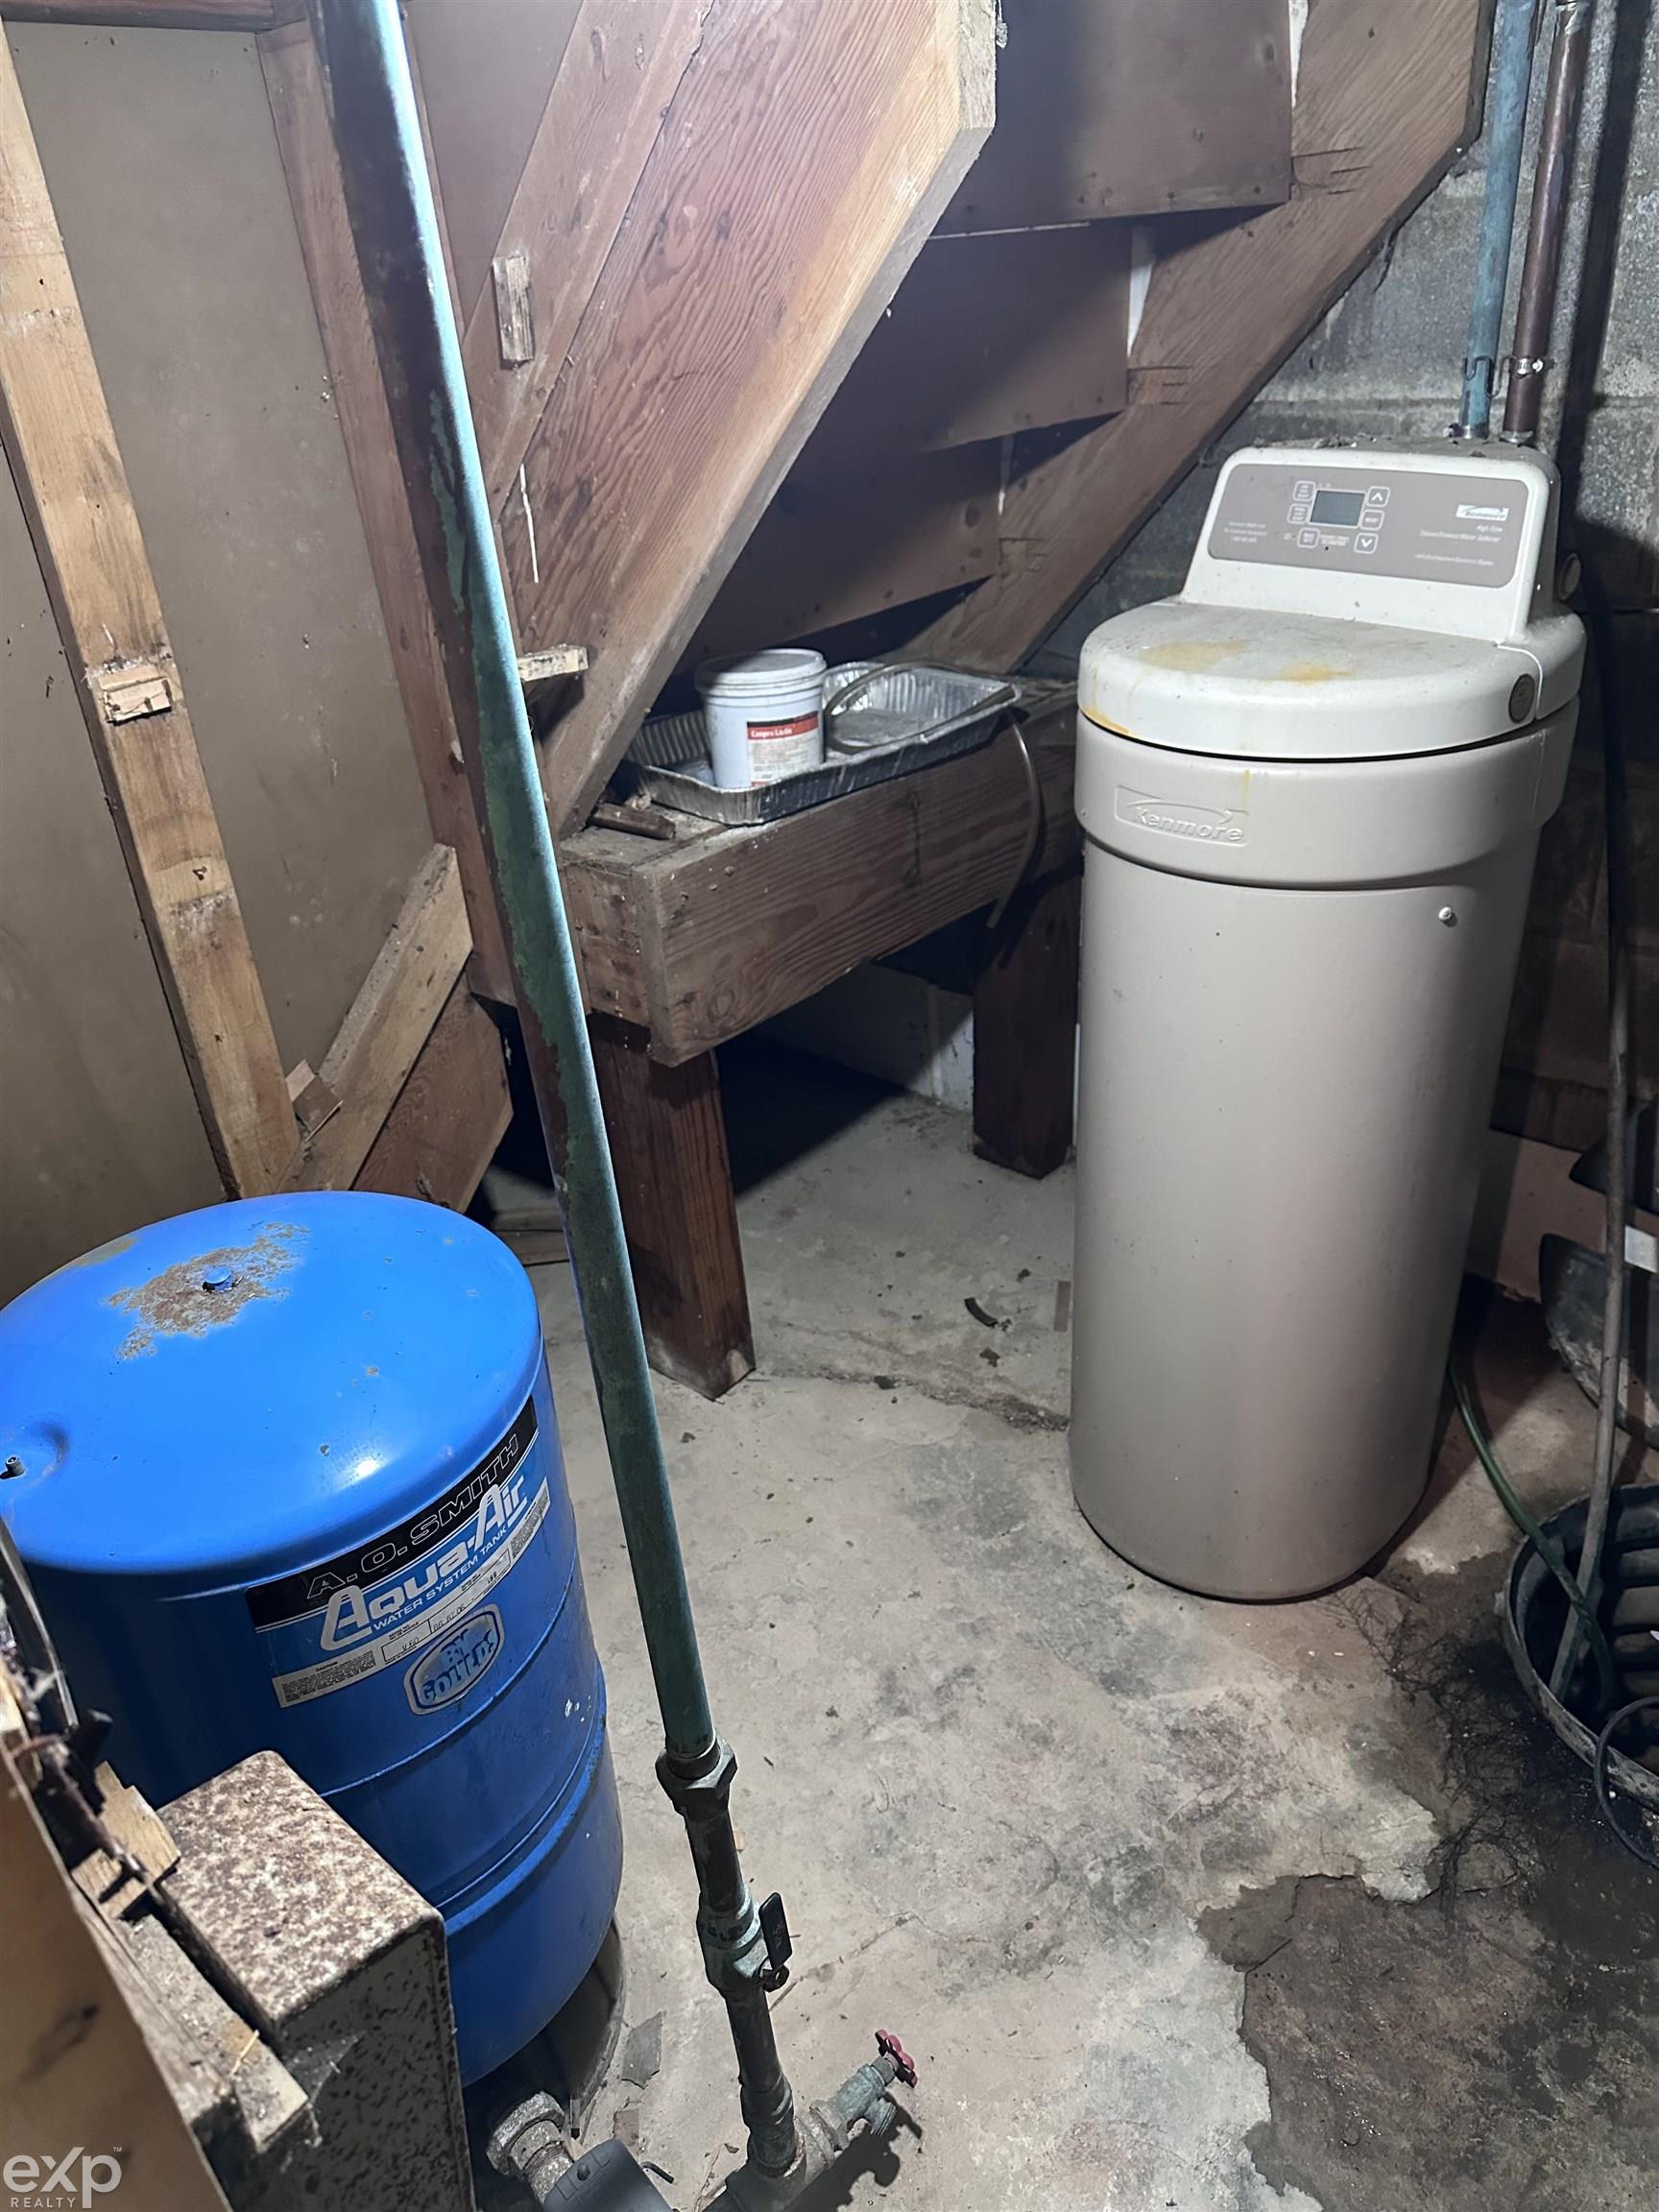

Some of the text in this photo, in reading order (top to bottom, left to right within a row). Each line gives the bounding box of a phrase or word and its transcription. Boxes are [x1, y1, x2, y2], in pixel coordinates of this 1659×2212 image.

[1135, 806, 1244, 841] Kenmore
[373, 1596, 422, 1631] WATER
[426, 1555, 478, 1600] SYSTEM
[481, 1527, 507, 1555] TANK
[421, 1629, 496, 1701] GOULDS
[439, 1628, 469, 1667] BY
